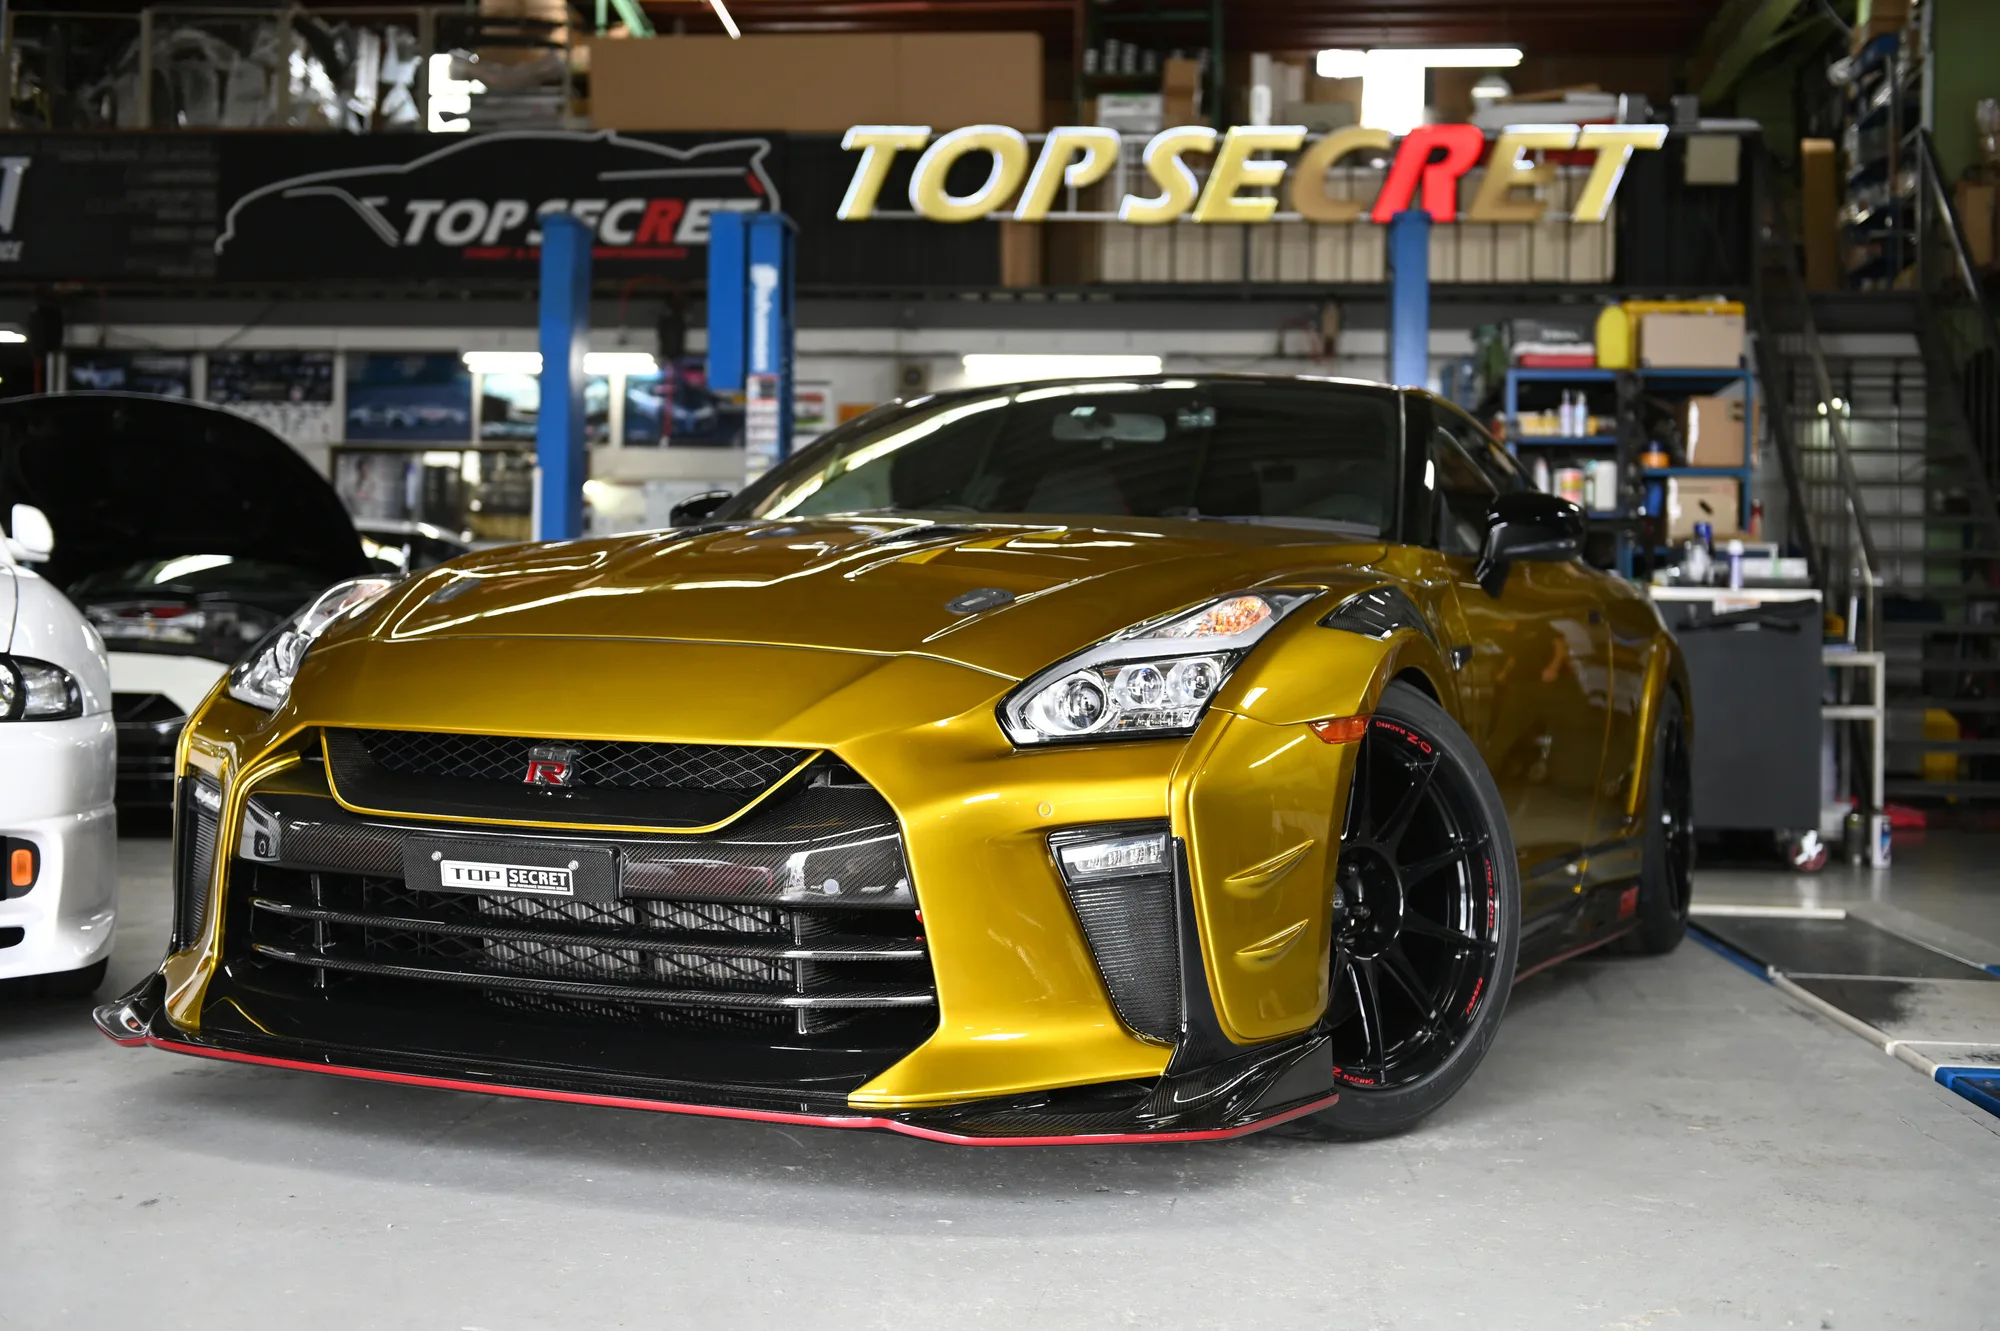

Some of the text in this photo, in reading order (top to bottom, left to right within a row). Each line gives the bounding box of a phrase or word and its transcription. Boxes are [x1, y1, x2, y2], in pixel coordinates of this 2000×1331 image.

[837, 124, 1669, 225] TOP SECRET
[405, 200, 526, 244] TOP
[450, 867, 568, 886] TOP SECRET
[1343, 1074, 1375, 1085] RACING
